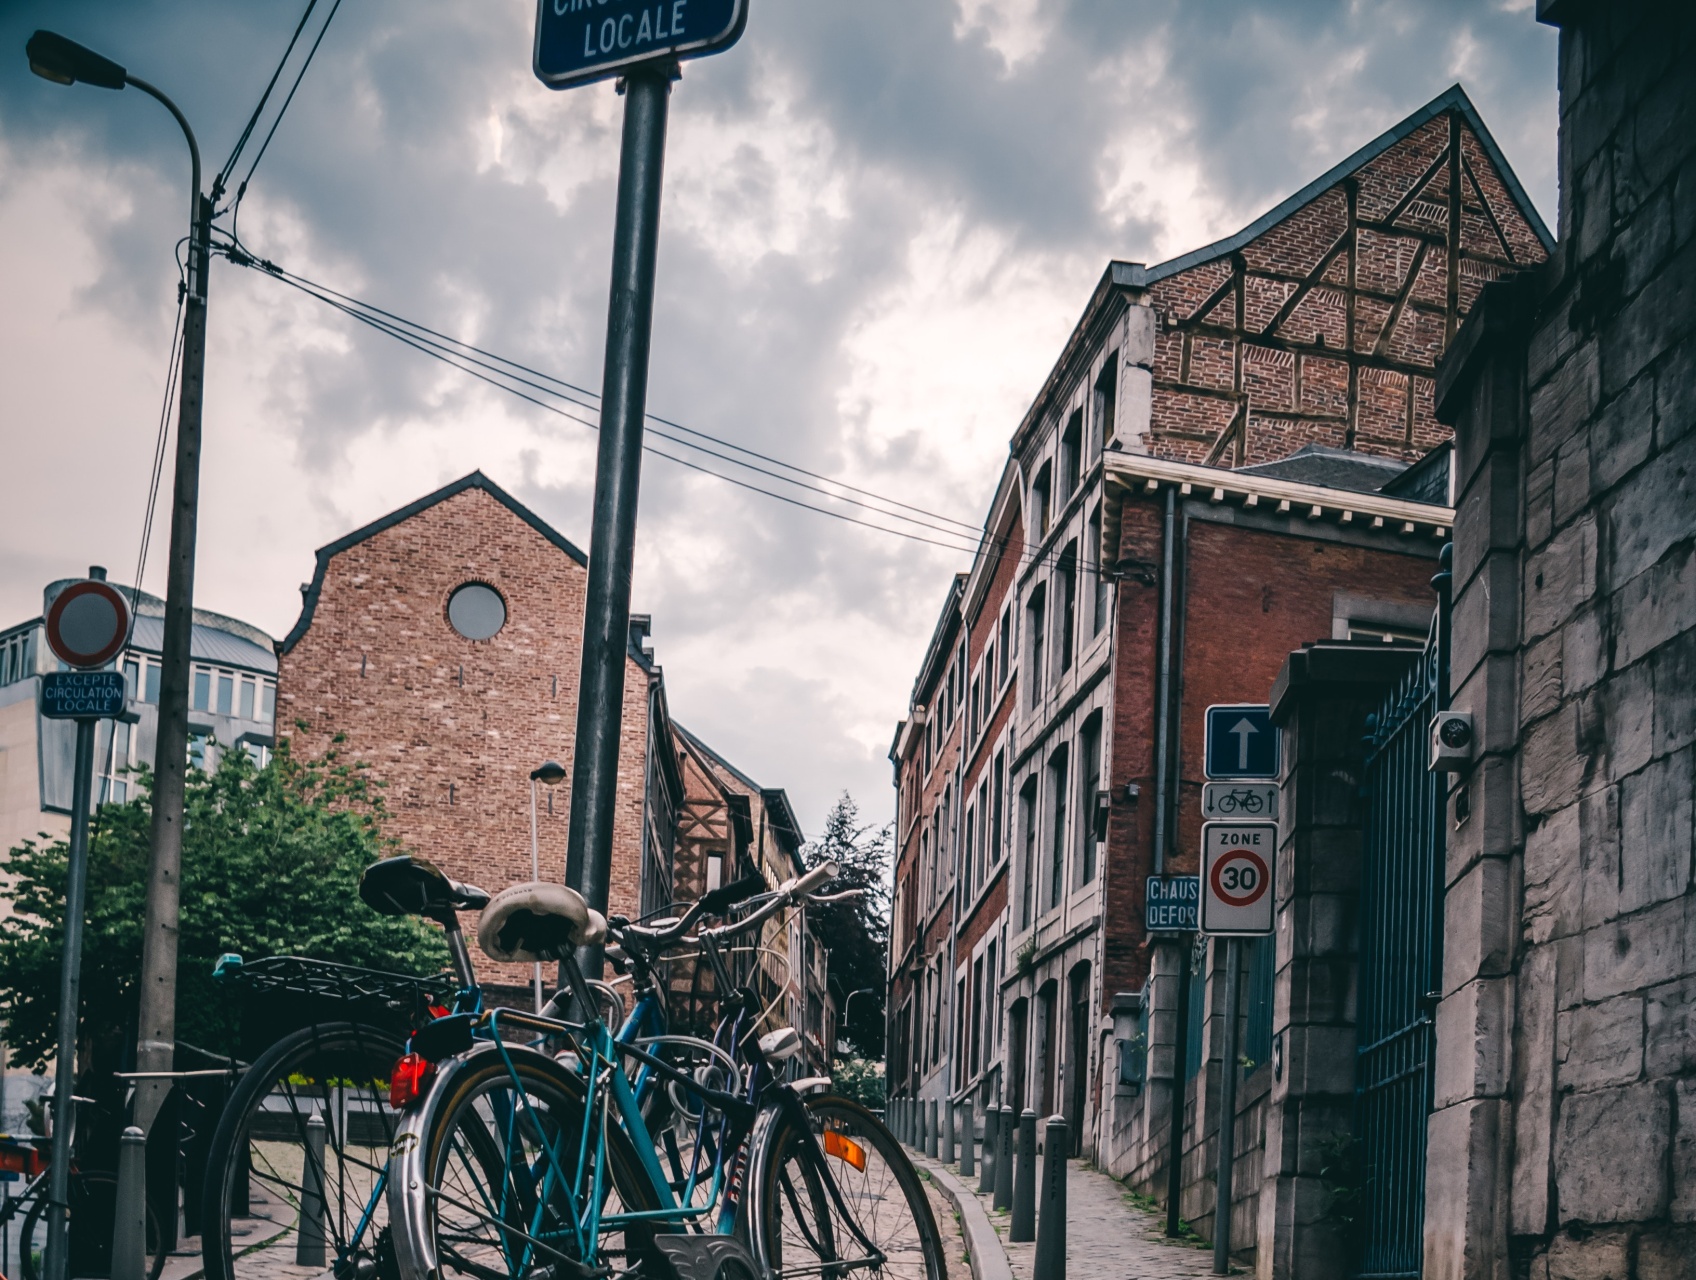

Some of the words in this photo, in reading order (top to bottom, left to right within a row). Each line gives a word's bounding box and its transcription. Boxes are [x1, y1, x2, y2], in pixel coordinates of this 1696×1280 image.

[584, 0, 687, 57] LOCALE
[56, 675, 117, 686] EXCEPTE
[45, 687, 122, 699] CIRCULATION
[57, 700, 111, 711] LOCALE
[1220, 833, 1261, 845] ZONE
[1223, 867, 1256, 890] 30
[1150, 881, 1197, 899] CHAUS
